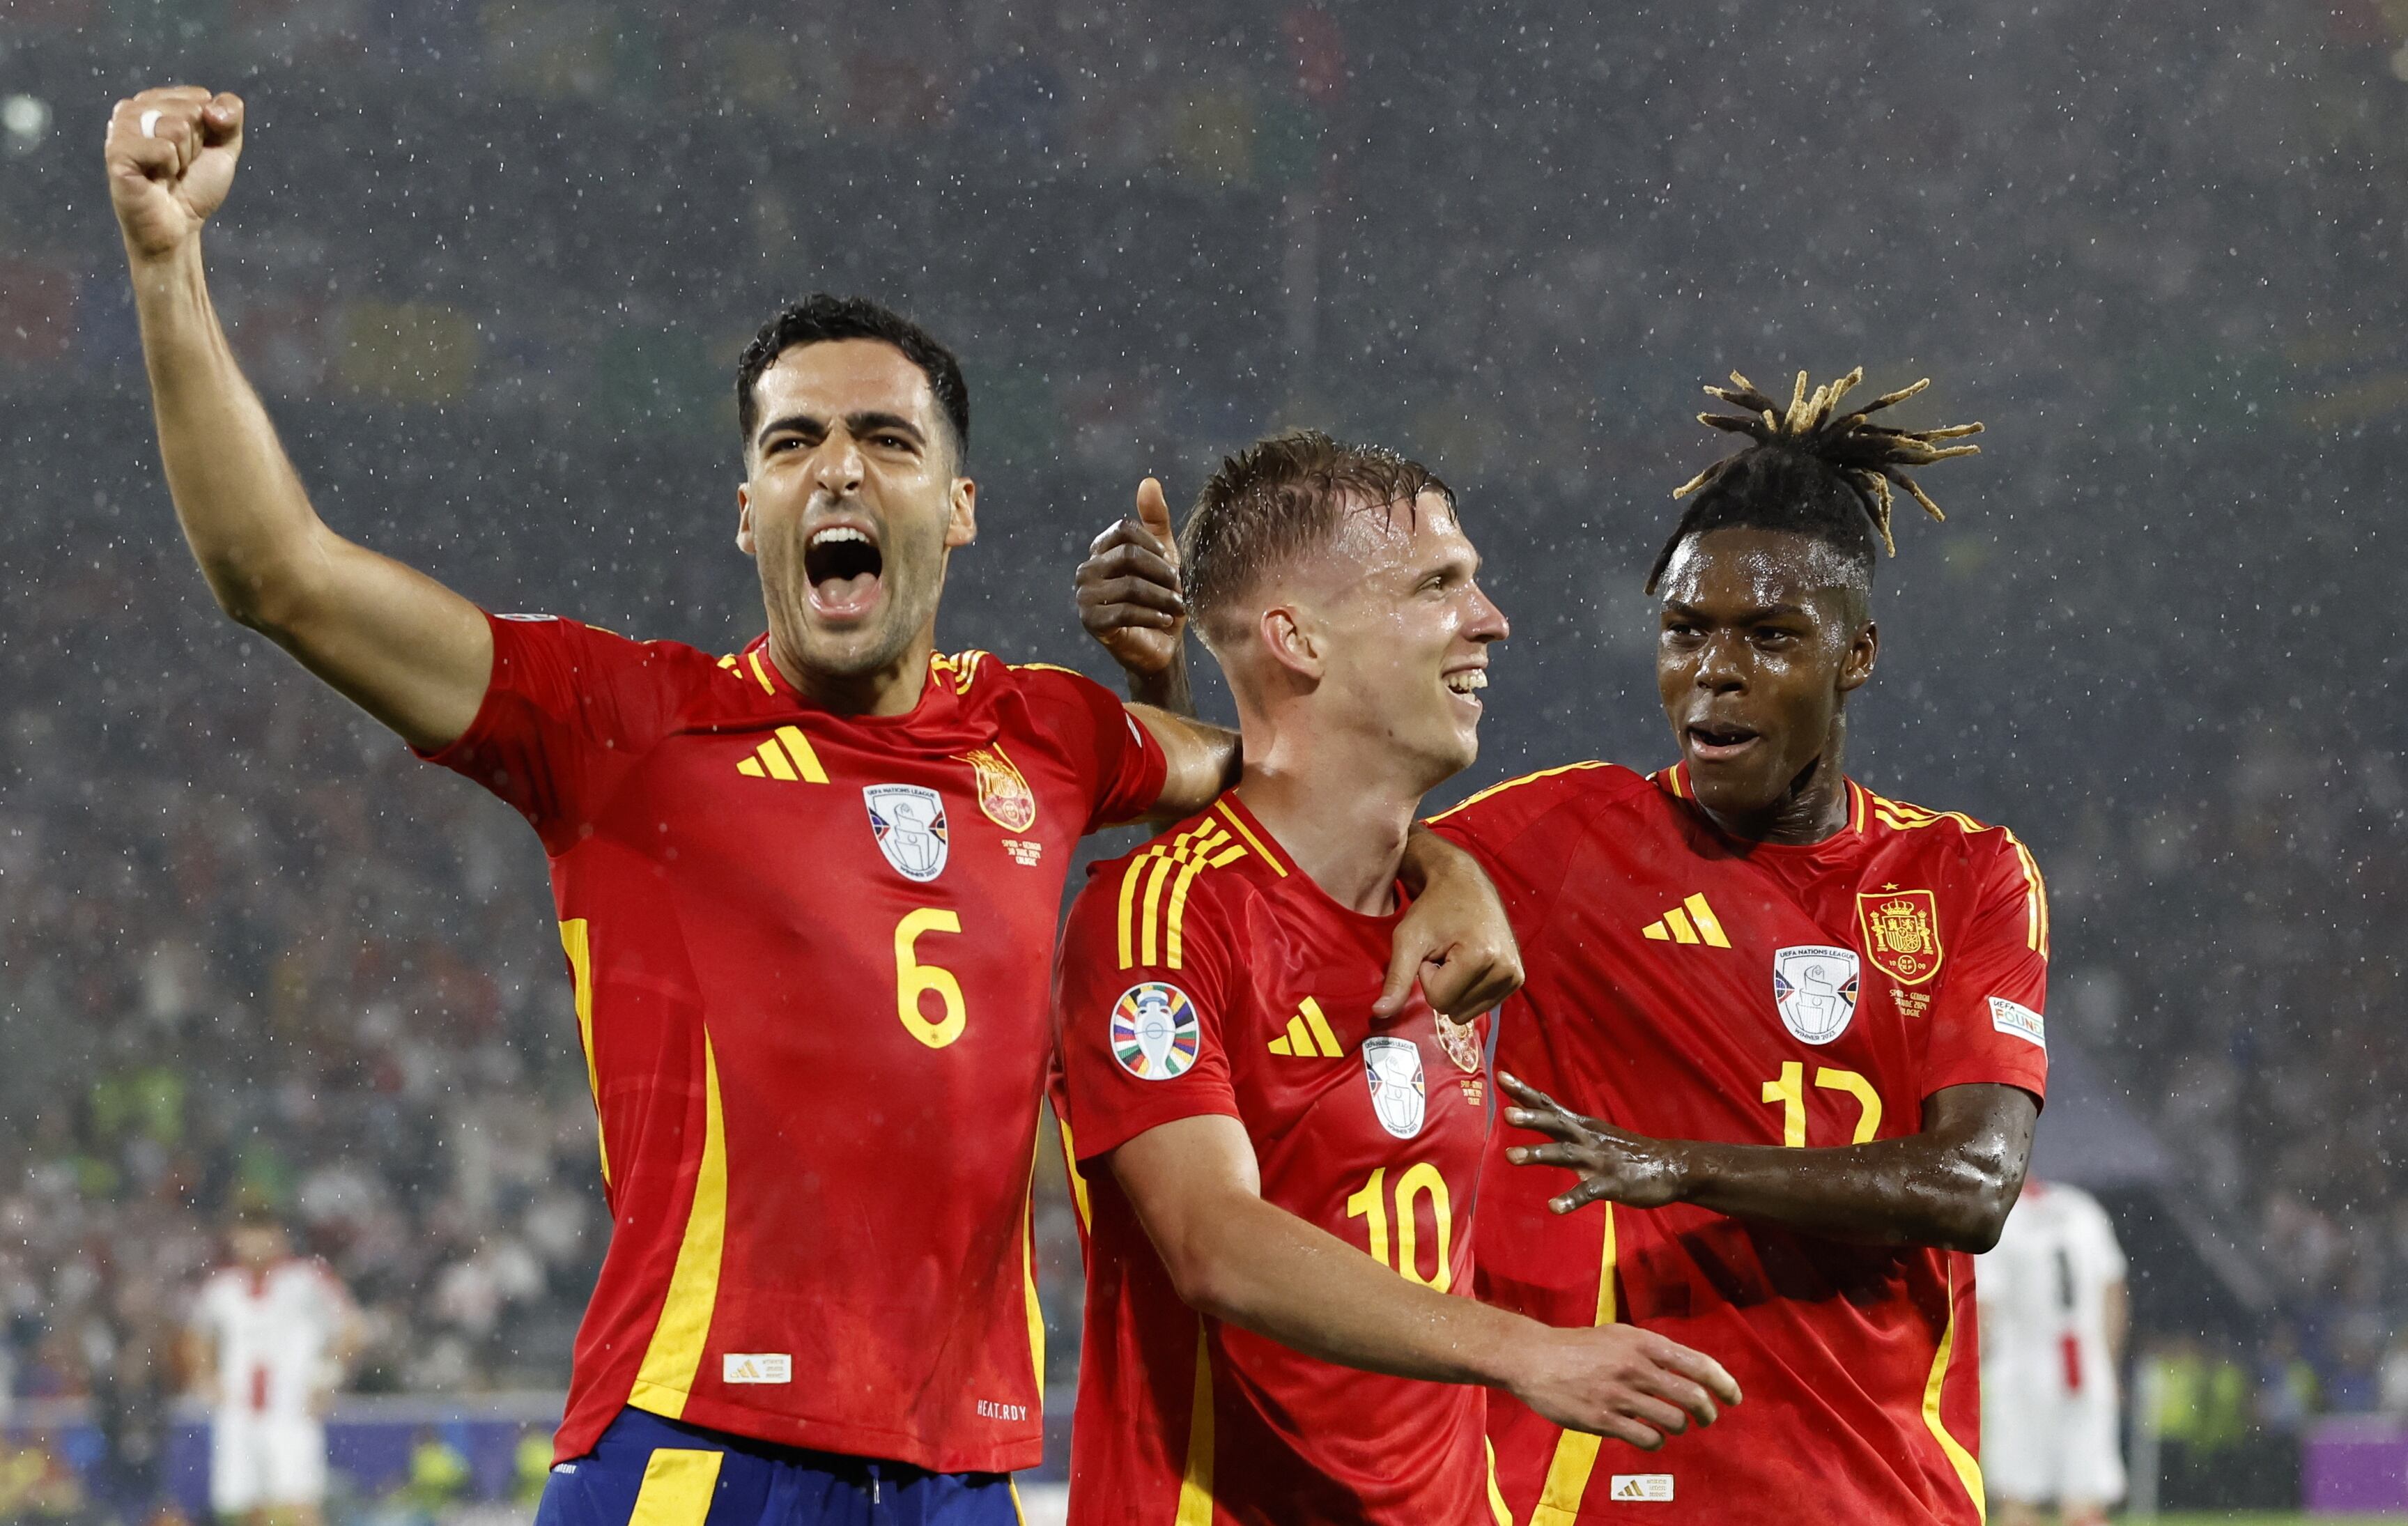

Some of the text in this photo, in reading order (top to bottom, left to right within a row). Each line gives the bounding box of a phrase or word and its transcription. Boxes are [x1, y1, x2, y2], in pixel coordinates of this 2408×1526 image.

[1780, 950, 1797, 958] UEFA
[1829, 950, 1855, 960] LEAGUE
[894, 907, 966, 1049] 6
[1993, 1000, 2015, 1012] UEFA
[1794, 1027, 1820, 1041] WINNER
[1347, 1162, 1452, 1295] 10
[977, 1398, 1026, 1421] HEAT.RDY
